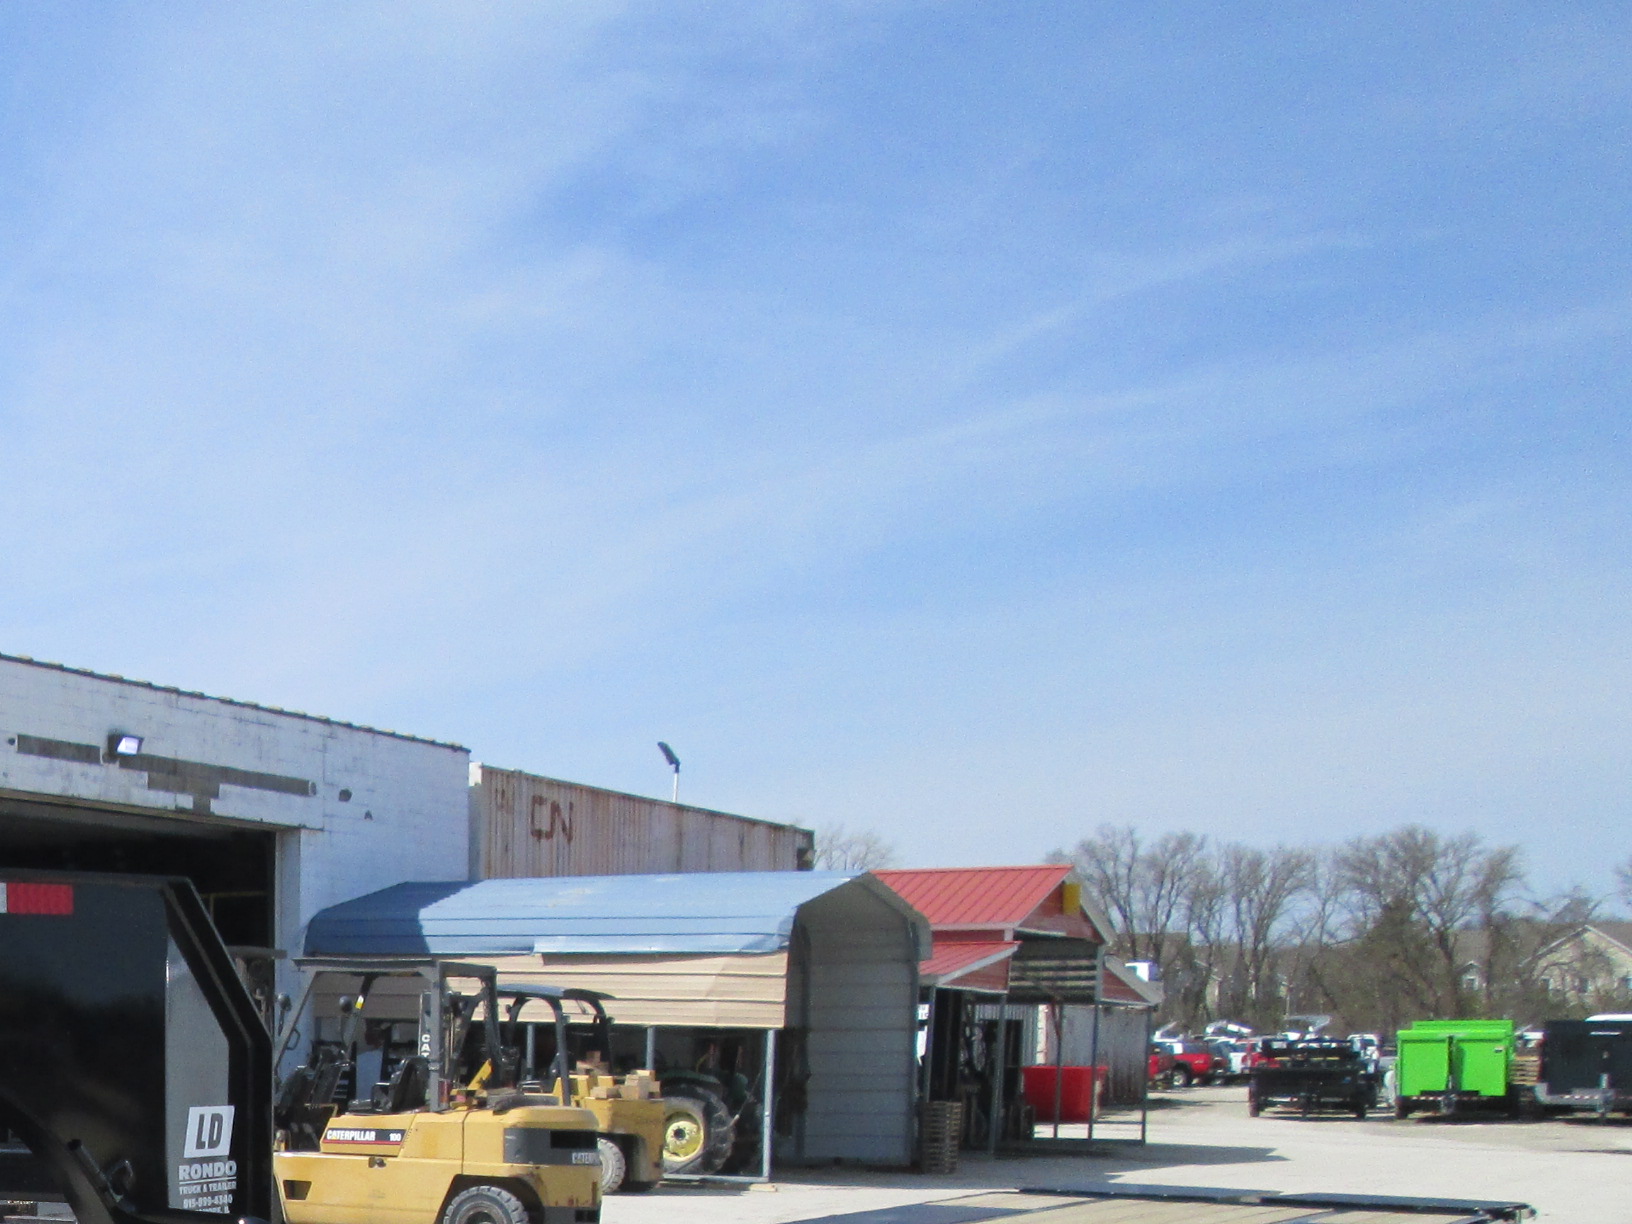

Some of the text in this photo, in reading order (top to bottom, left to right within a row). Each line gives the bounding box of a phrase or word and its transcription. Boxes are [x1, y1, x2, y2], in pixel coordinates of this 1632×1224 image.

[530, 795, 574, 844] CN
[195, 1112, 224, 1150] LD
[326, 1129, 402, 1142] CATERPILLAR 100
[178, 1160, 237, 1181] RONDO
[179, 1184, 201, 1195] TRUCK
[209, 1180, 237, 1192] TRAILER
